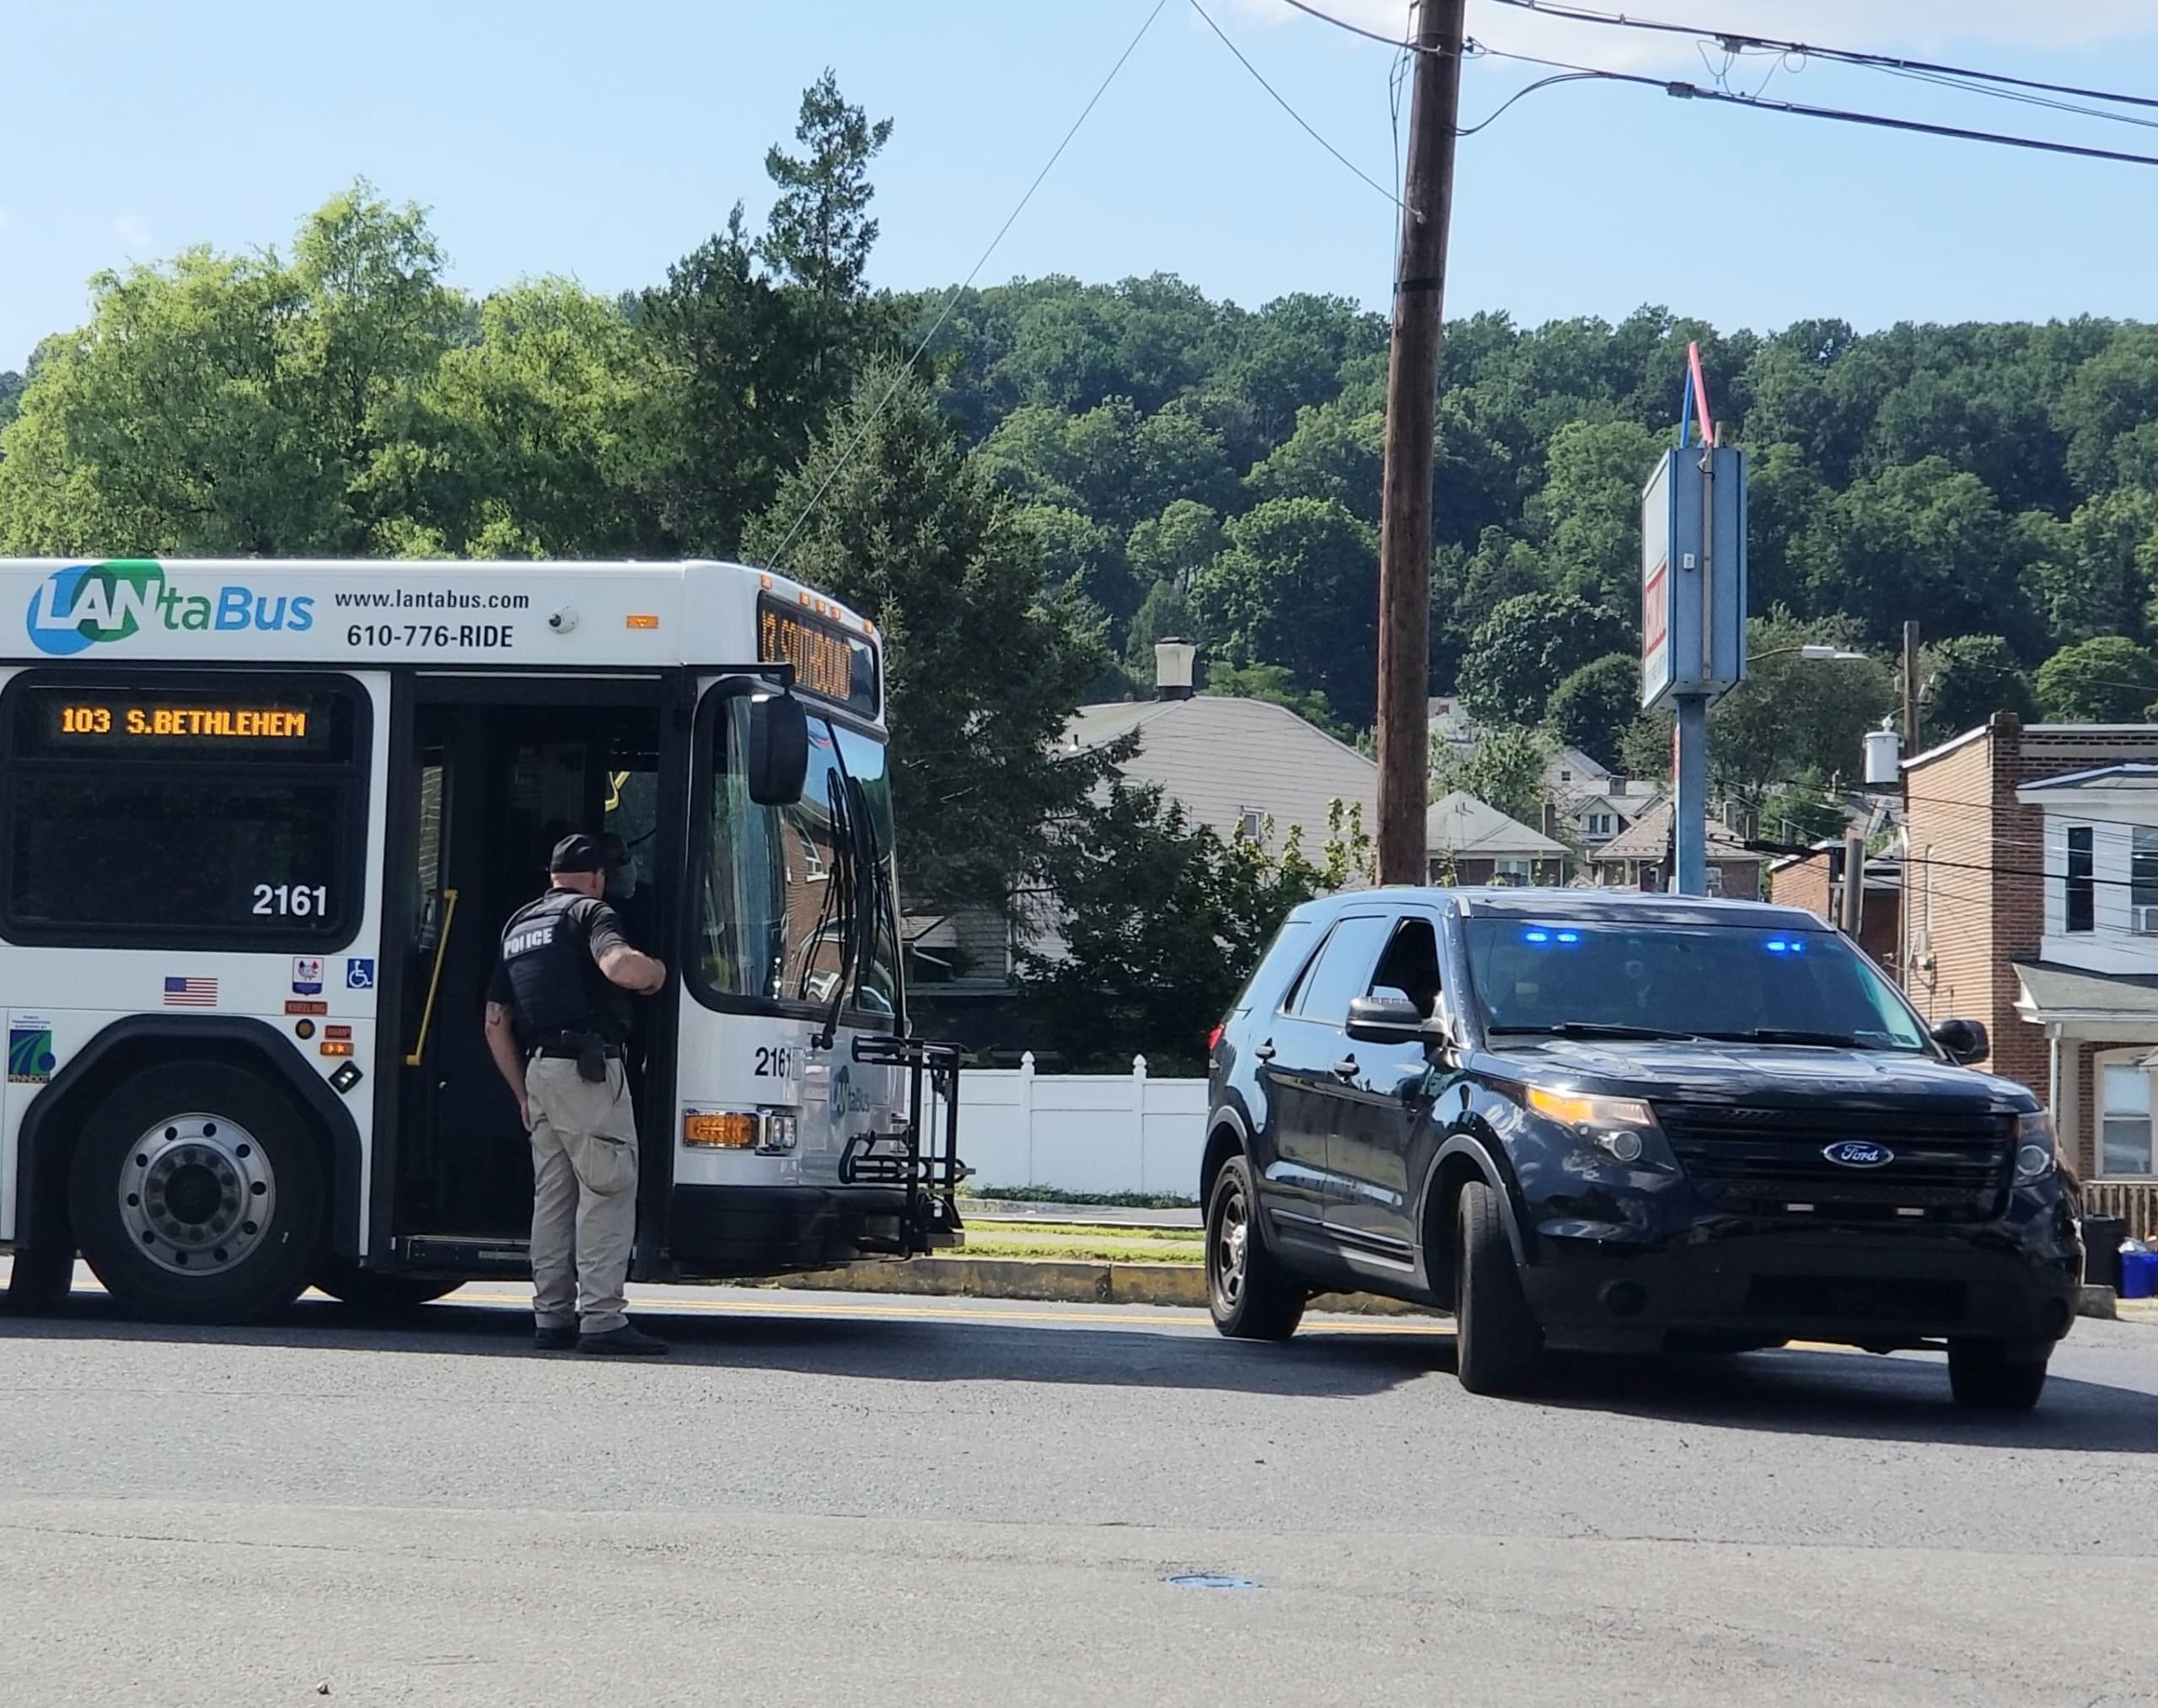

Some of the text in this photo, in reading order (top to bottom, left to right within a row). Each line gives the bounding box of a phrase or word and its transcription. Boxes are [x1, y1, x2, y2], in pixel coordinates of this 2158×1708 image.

[35, 578, 315, 631] LANtaBus
[335, 588, 529, 610] www.lantabus.com
[346, 625, 513, 647] 610-776-RIDE
[62, 707, 306, 737] 103 S.BETHLEHEM
[252, 884, 326, 916] 2161
[754, 1046, 792, 1078] 2161
[1841, 1144, 1879, 1162] Ford
